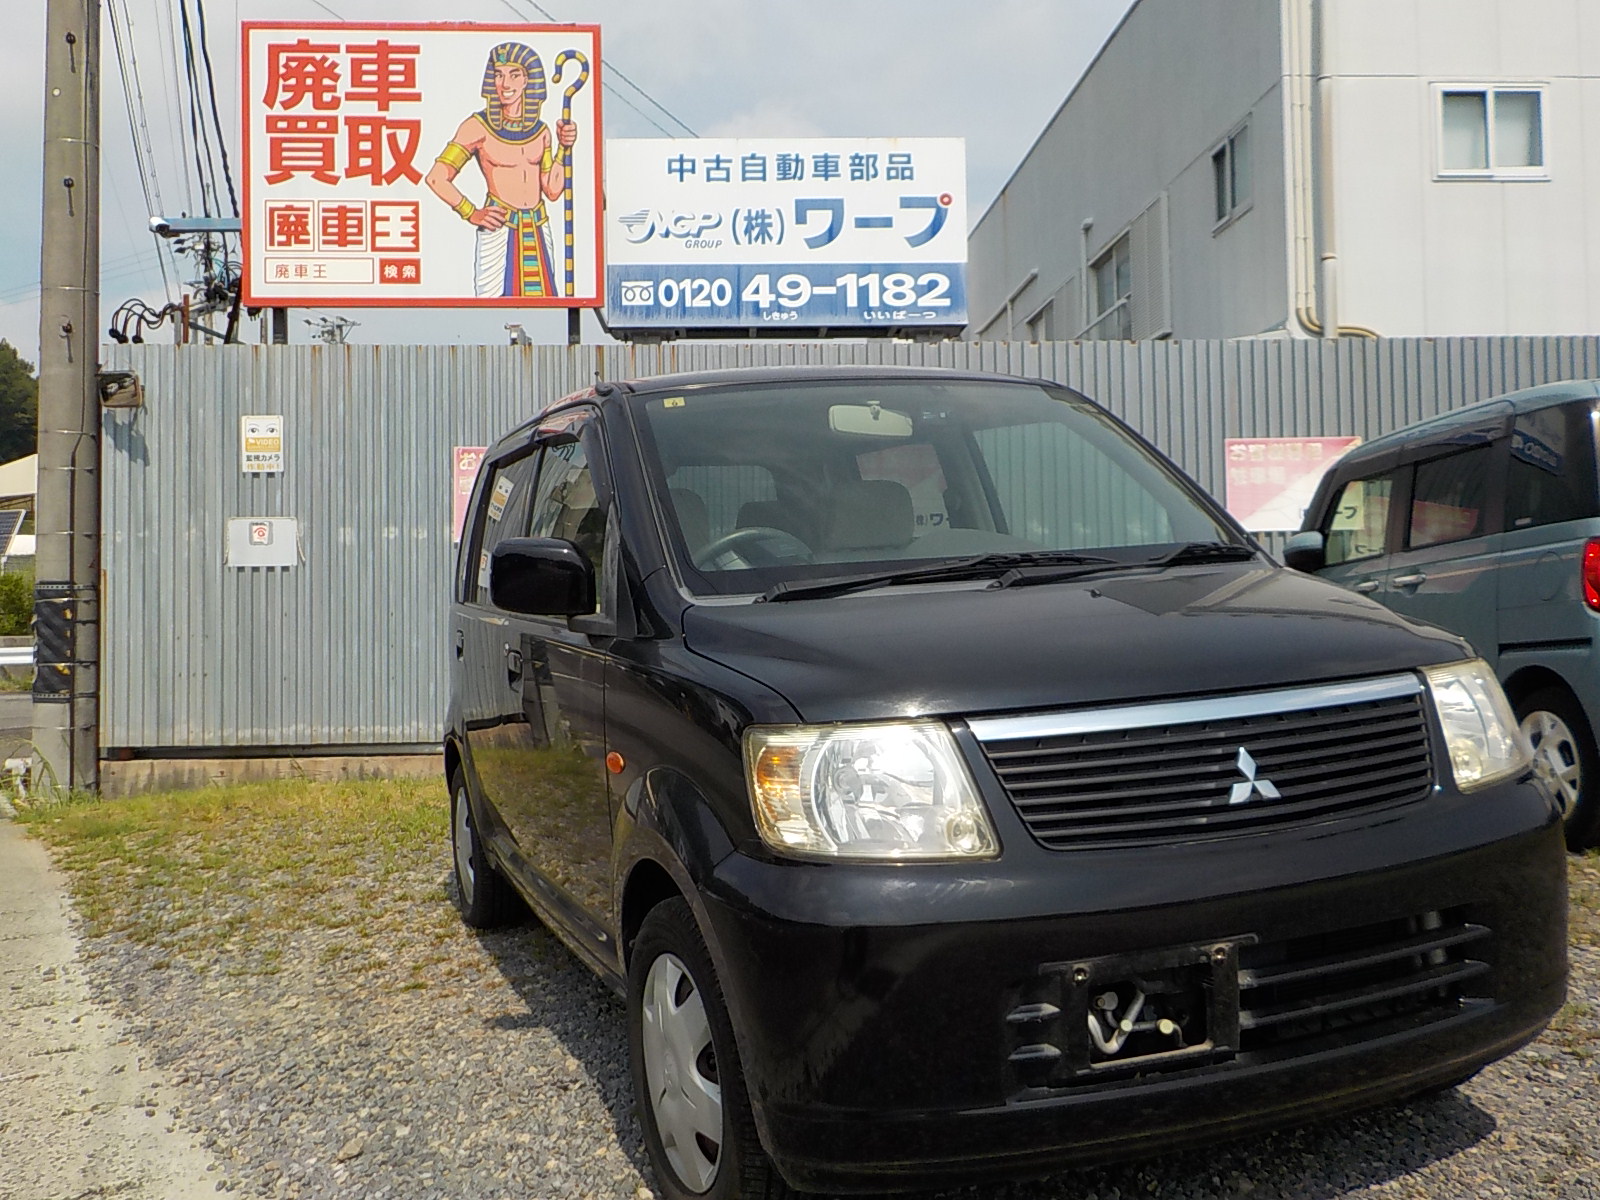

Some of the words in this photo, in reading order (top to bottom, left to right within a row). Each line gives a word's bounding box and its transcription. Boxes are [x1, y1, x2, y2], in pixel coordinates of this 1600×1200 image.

[262, 38, 422, 112] 廃車
[263, 114, 423, 186] 買取
[667, 153, 914, 182] 中古自動車部品
[268, 203, 419, 251] 廃車王
[684, 239, 723, 249] GROUP
[274, 263, 328, 279] 廃車王
[383, 264, 417, 279] 検索
[658, 278, 732, 308] 0120
[741, 272, 951, 308] 49-1182
[762, 311, 799, 321] しきゅう
[256, 438, 279, 446] VIDEO
